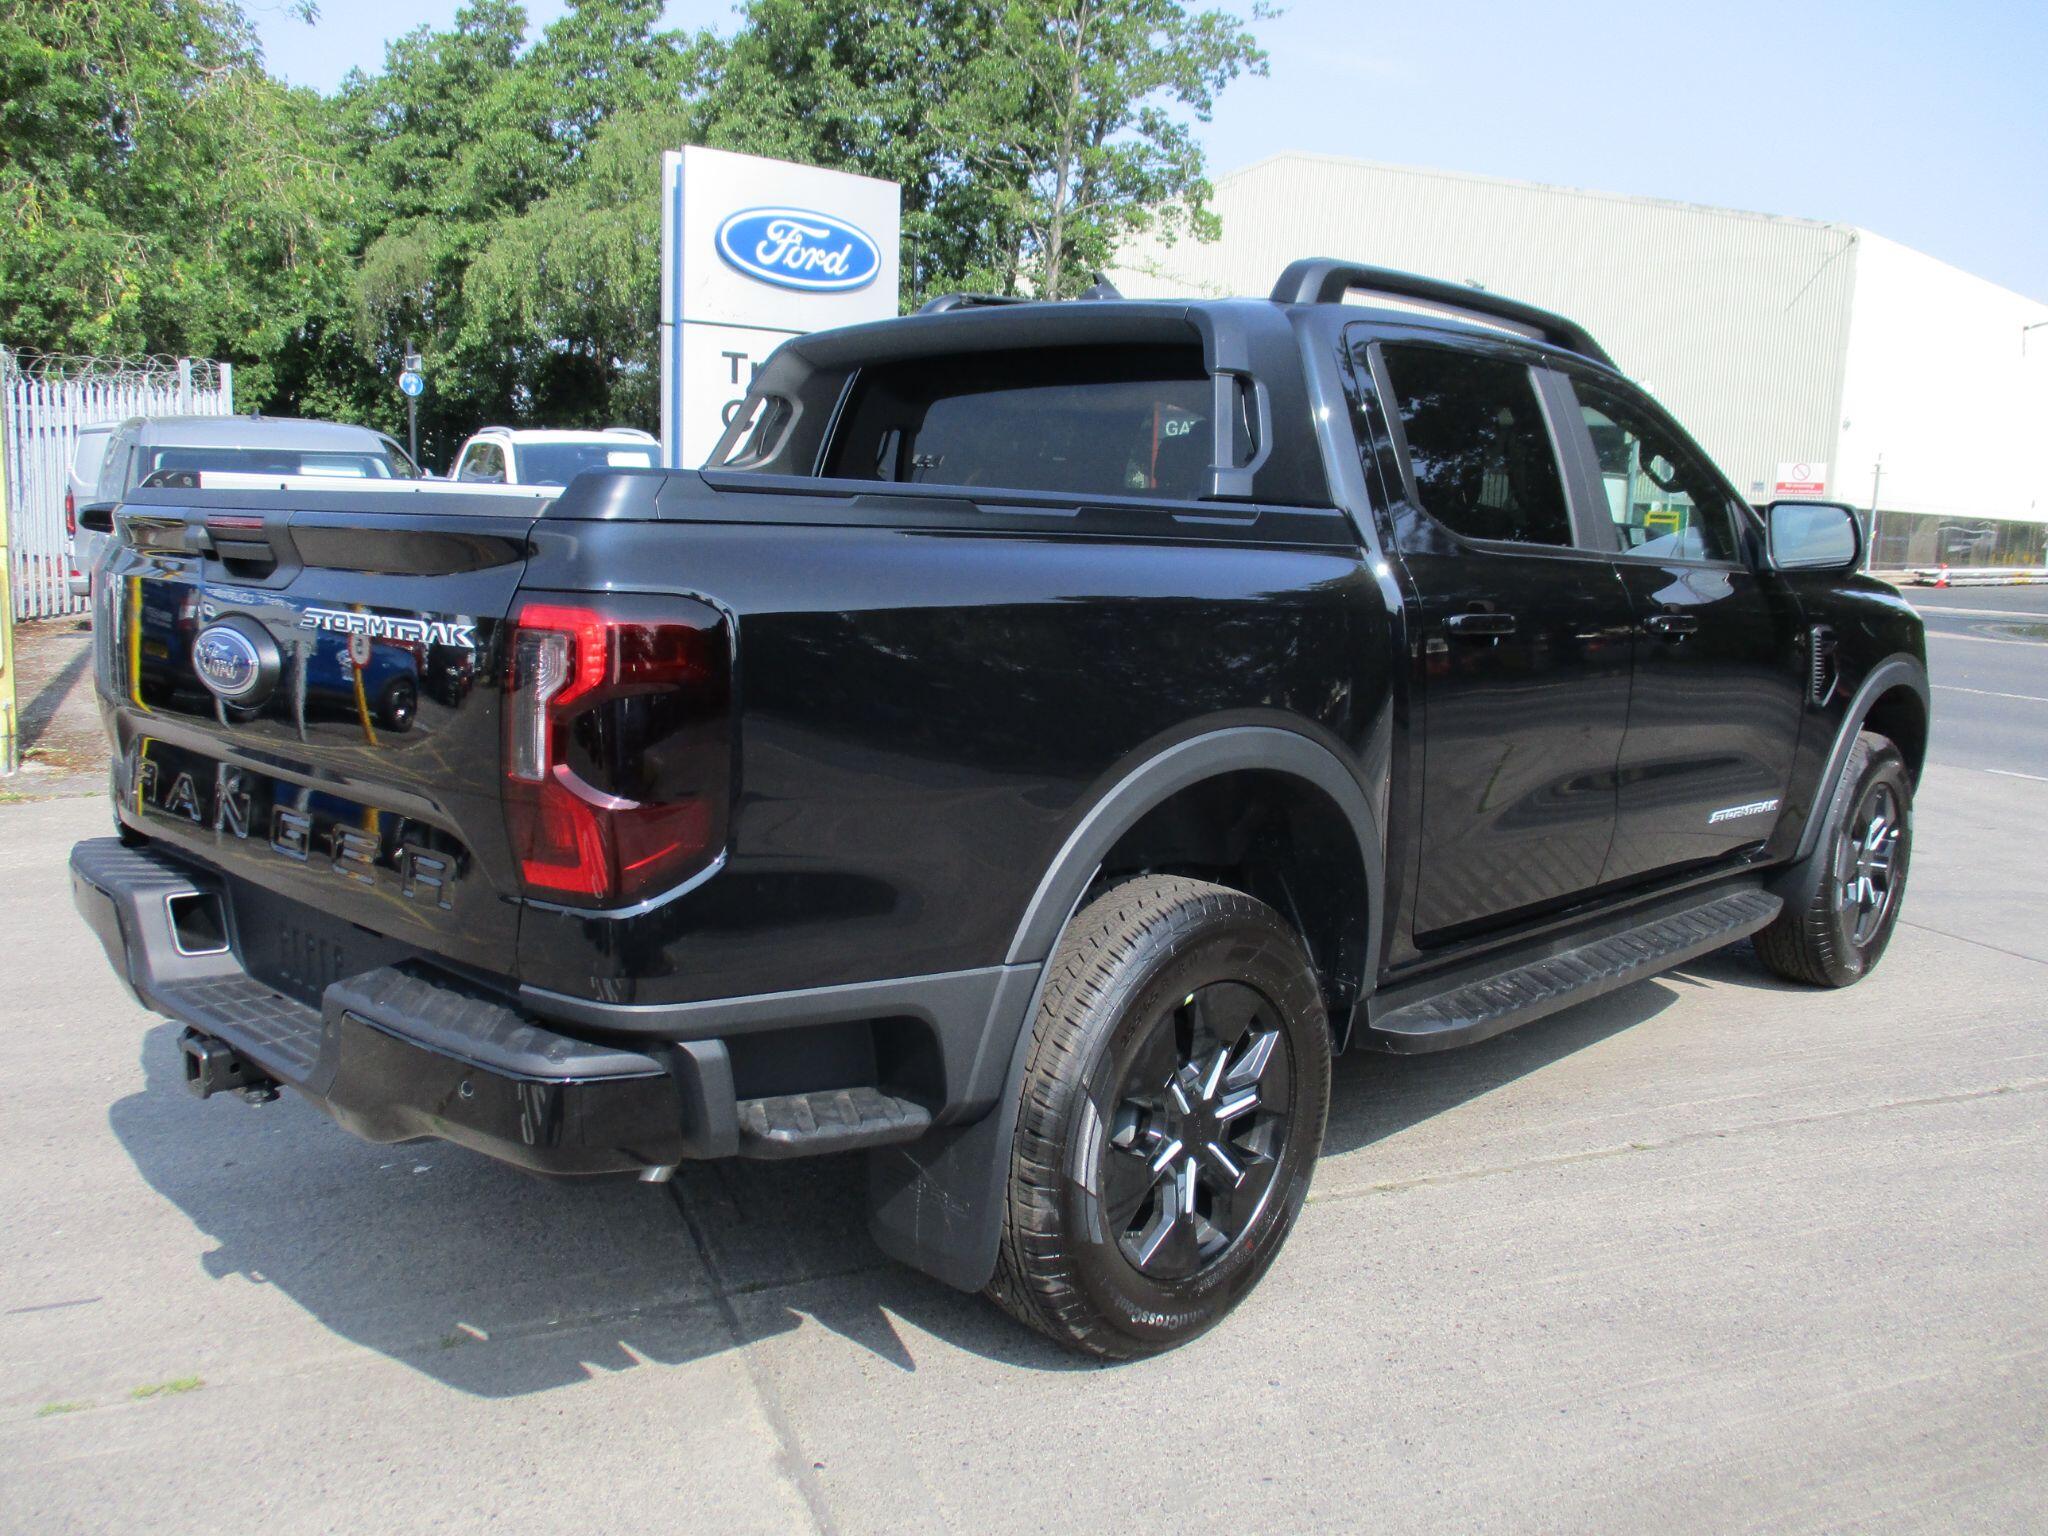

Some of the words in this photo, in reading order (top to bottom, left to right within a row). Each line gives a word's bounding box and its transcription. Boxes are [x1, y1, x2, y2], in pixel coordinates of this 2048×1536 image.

[756, 219, 852, 276] Ford
[299, 607, 477, 648] STORMTRAK
[199, 640, 239, 680] Ford
[132, 756, 457, 911] RANGER
